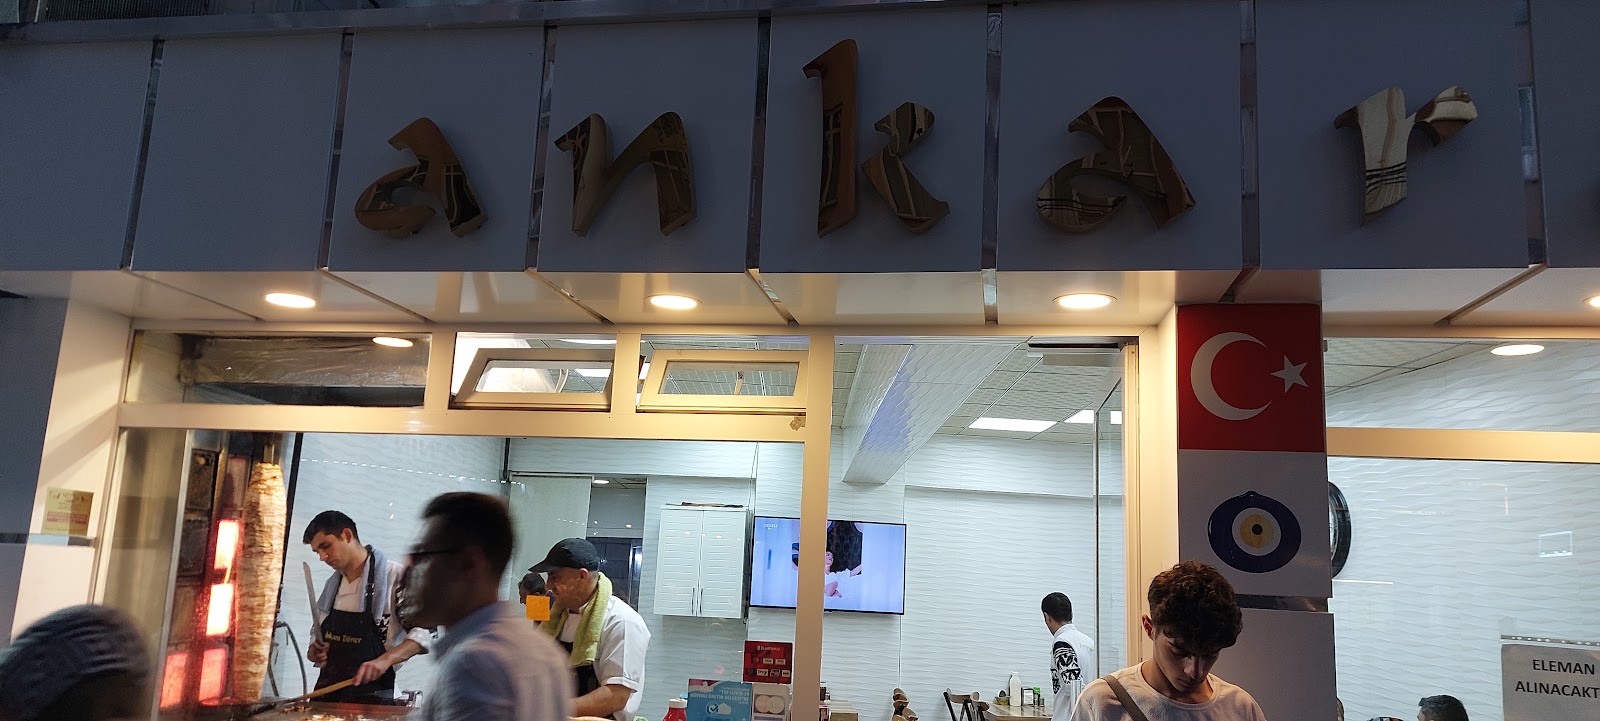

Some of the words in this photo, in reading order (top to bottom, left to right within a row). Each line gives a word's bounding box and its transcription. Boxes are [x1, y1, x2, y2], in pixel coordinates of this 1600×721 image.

[354, 38, 1600, 238] ankar
[1532, 659, 1595, 675] ELEMAN
[1515, 680, 1600, 699] ALINACAKT
